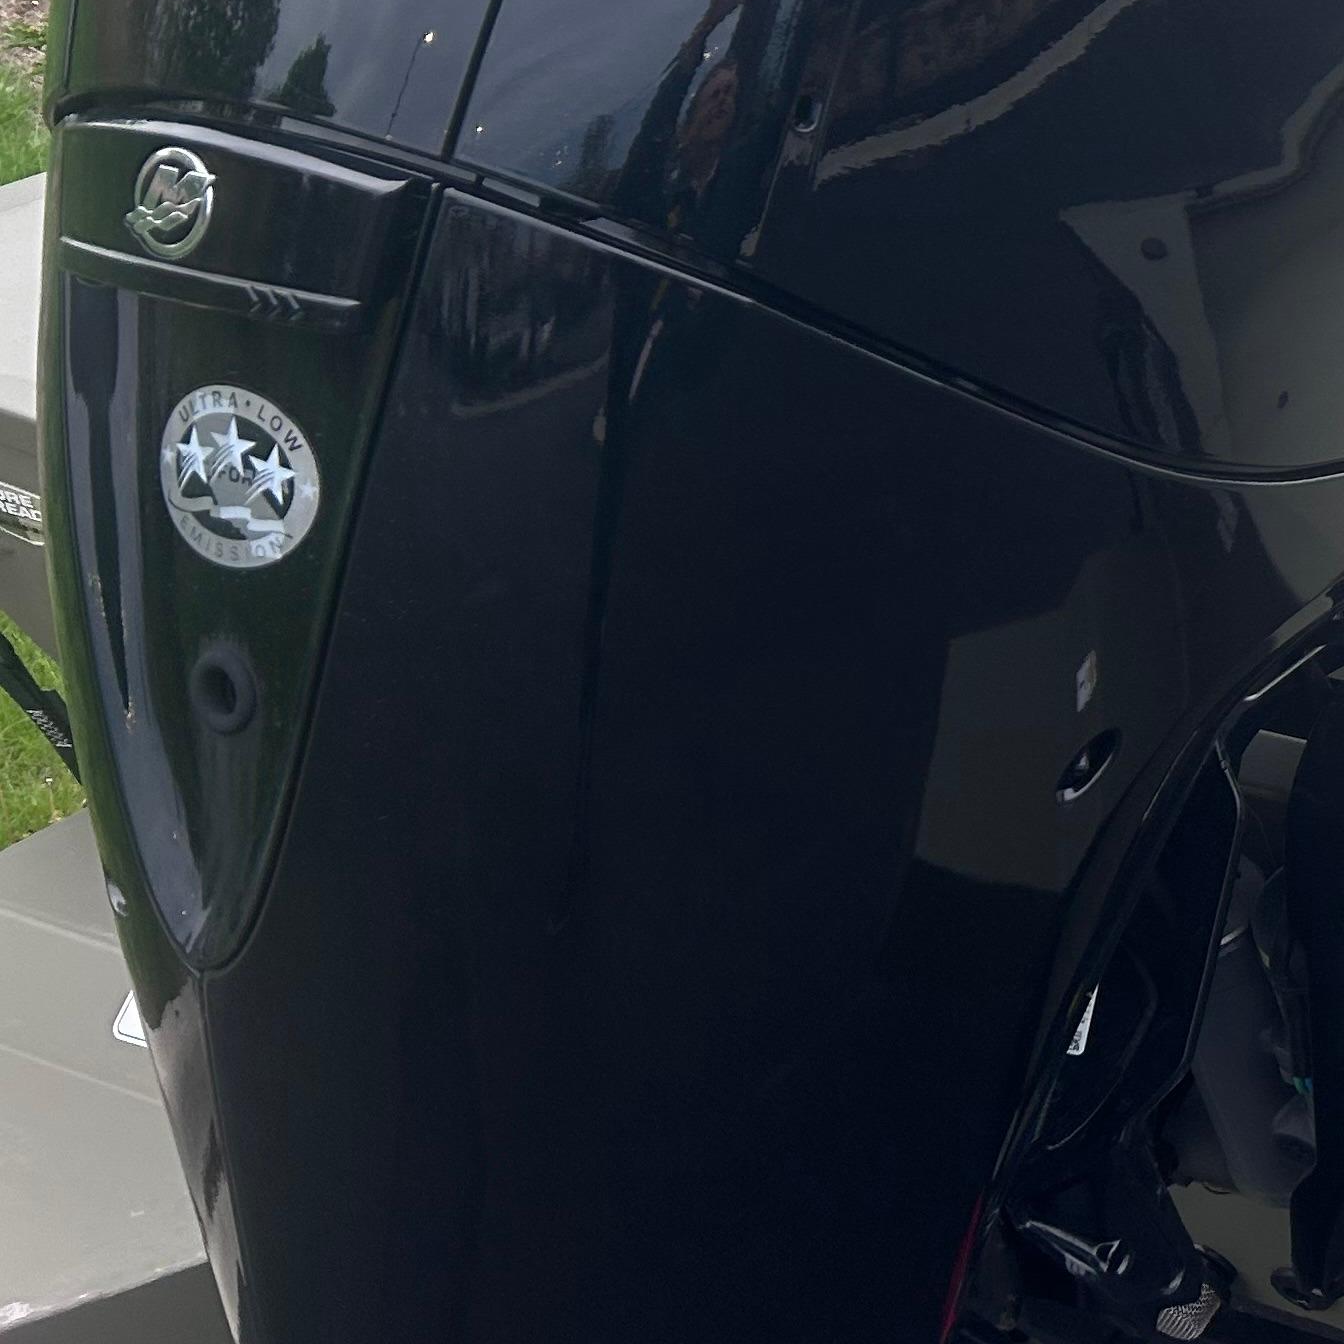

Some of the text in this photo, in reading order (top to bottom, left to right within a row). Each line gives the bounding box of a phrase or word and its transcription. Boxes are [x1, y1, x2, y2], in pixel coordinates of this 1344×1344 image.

[179, 391, 303, 452] ULTRA LOW
[180, 515, 284, 561] EMISSION
